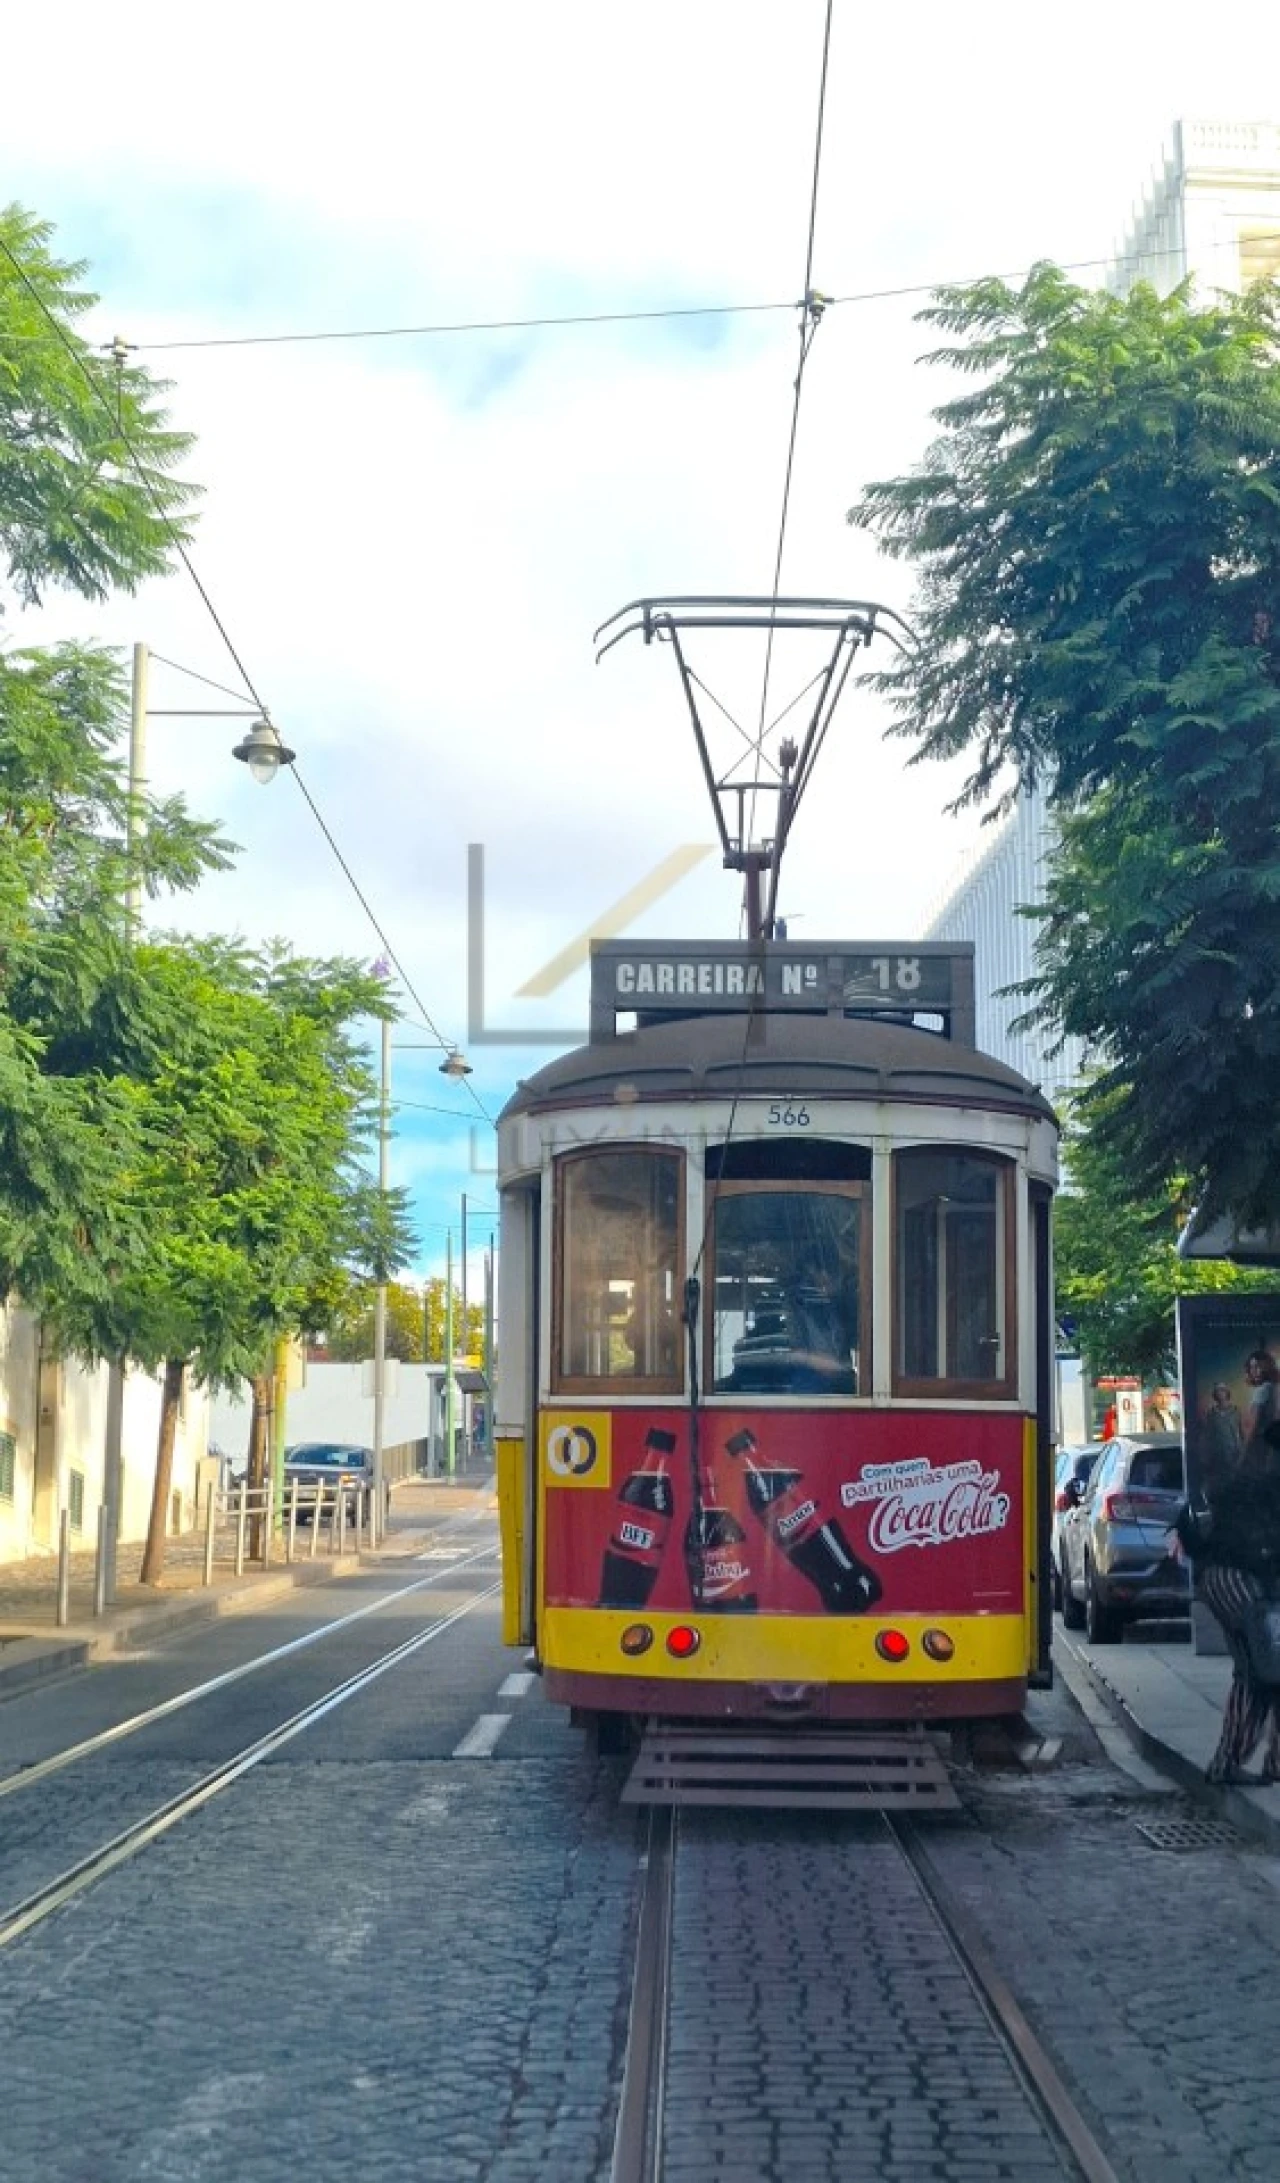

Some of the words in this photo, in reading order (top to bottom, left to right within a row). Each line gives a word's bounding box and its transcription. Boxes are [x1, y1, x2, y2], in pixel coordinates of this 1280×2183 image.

[616, 963, 765, 994] CARREIRA
[782, 963, 818, 995] Nº
[871, 957, 922, 991] 18
[767, 1104, 811, 1127] 566
[895, 1461, 929, 1476] quem
[947, 1463, 980, 1481] uma
